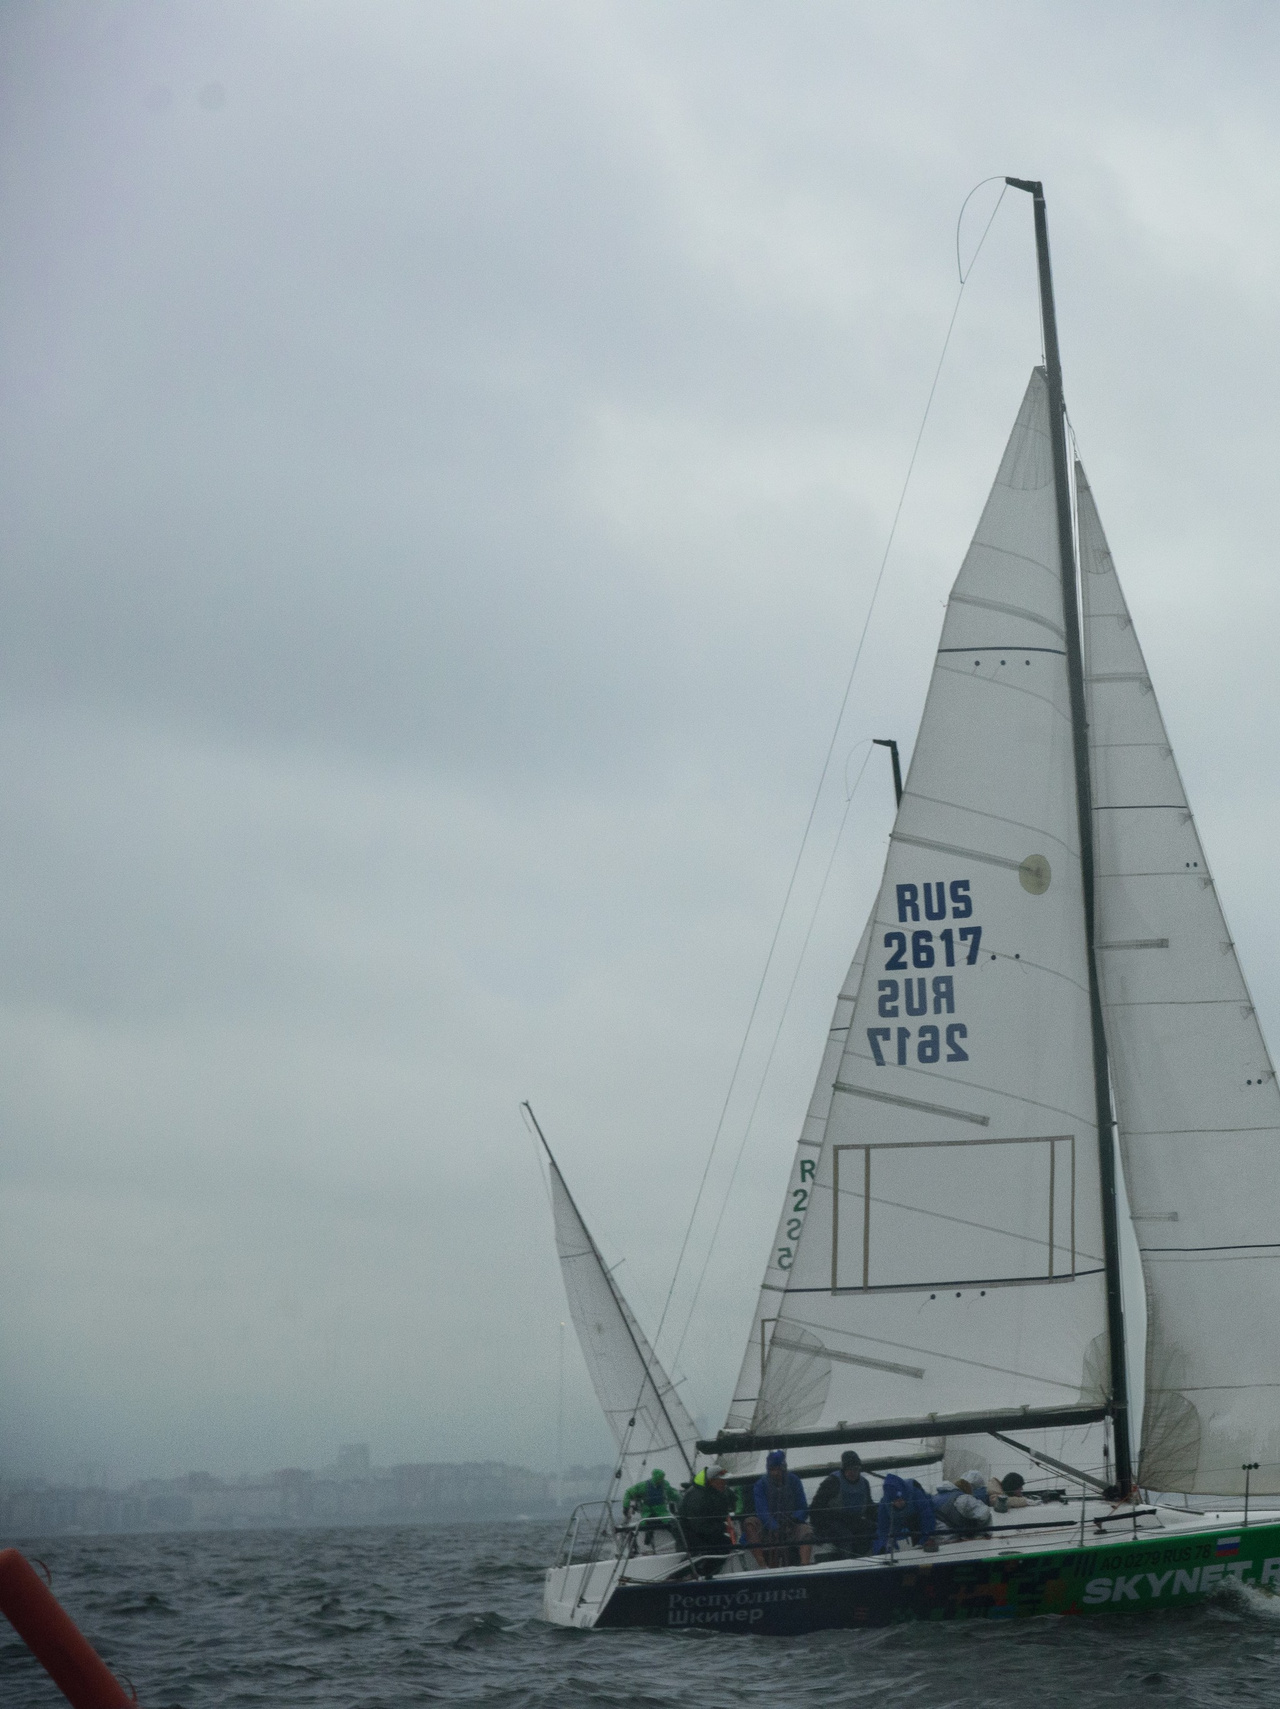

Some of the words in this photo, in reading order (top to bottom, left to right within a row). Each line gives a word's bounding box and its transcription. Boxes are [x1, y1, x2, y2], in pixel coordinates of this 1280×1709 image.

[896, 880, 973, 922] RUS
[884, 926, 982, 970] 2617
[1163, 1546, 1192, 1563] RUS
[668, 1586, 808, 1609] Республика
[668, 1608, 764, 1625] Шкипер
